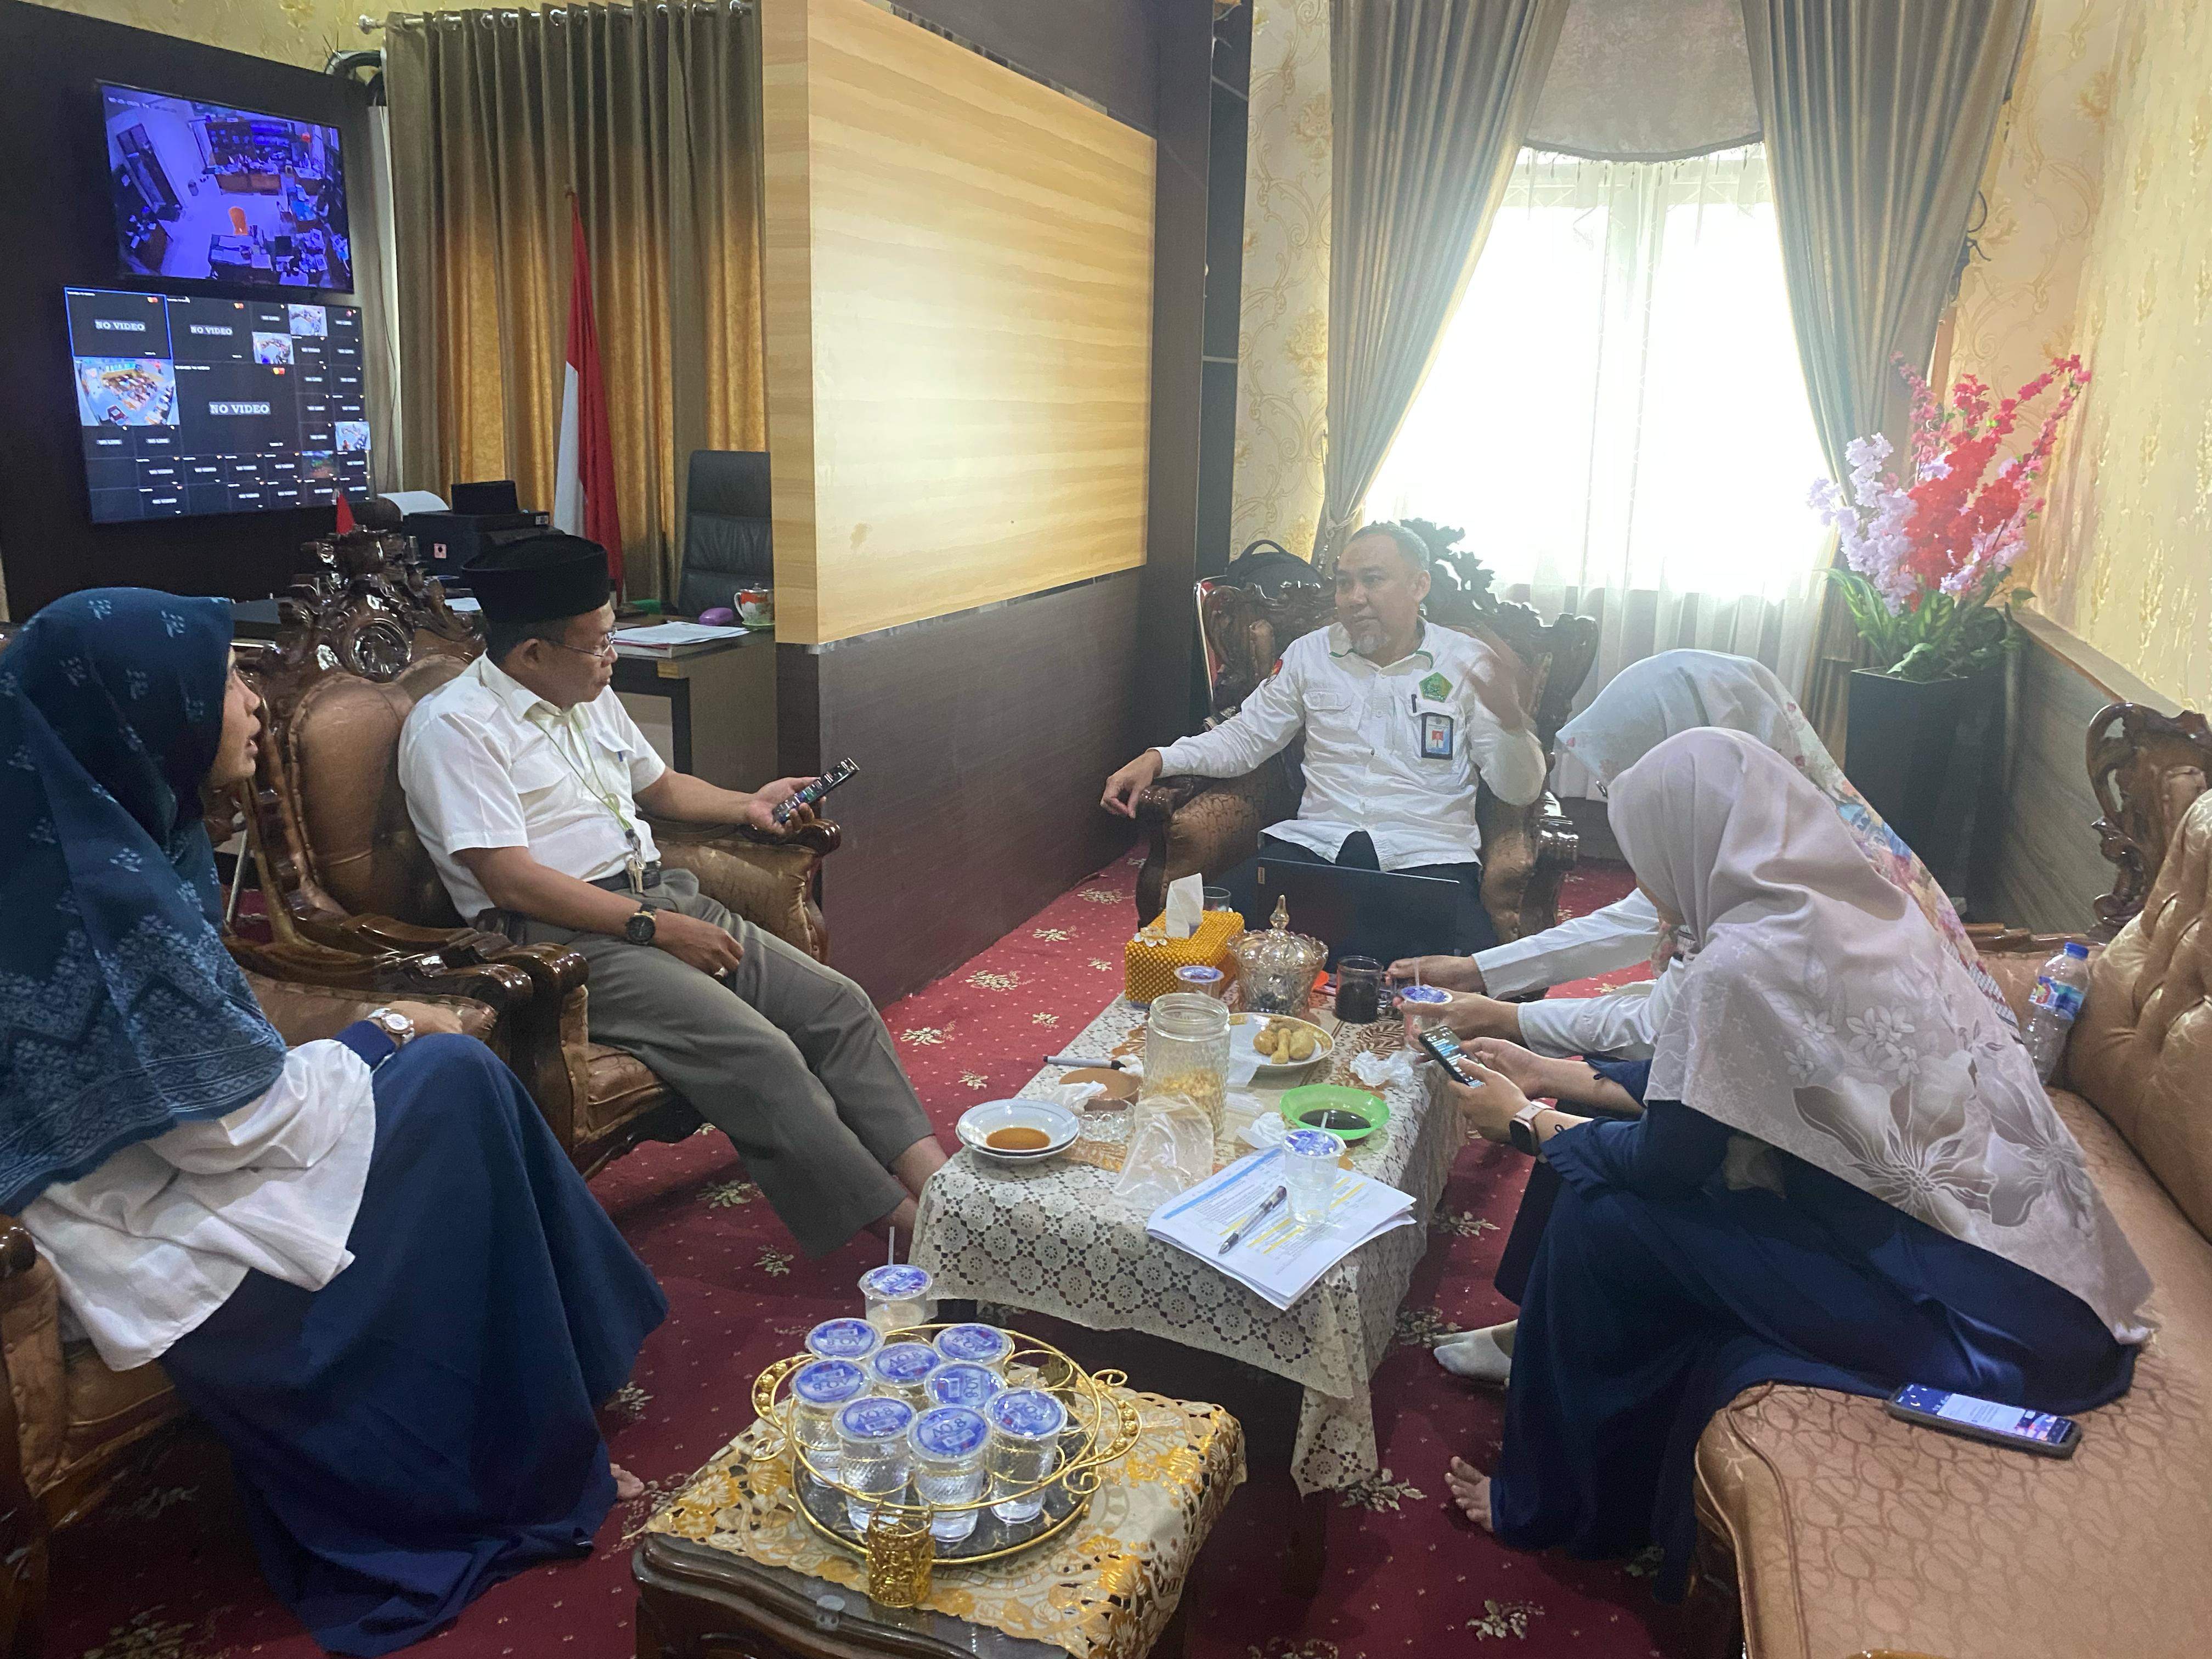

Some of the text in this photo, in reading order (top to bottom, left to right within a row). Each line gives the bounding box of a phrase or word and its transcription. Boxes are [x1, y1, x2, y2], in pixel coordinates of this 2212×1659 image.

[95, 321, 145, 331] NO VIDEO
[190, 326, 233, 335] NO VIDEO
[210, 404, 269, 414] NO VIDEO
